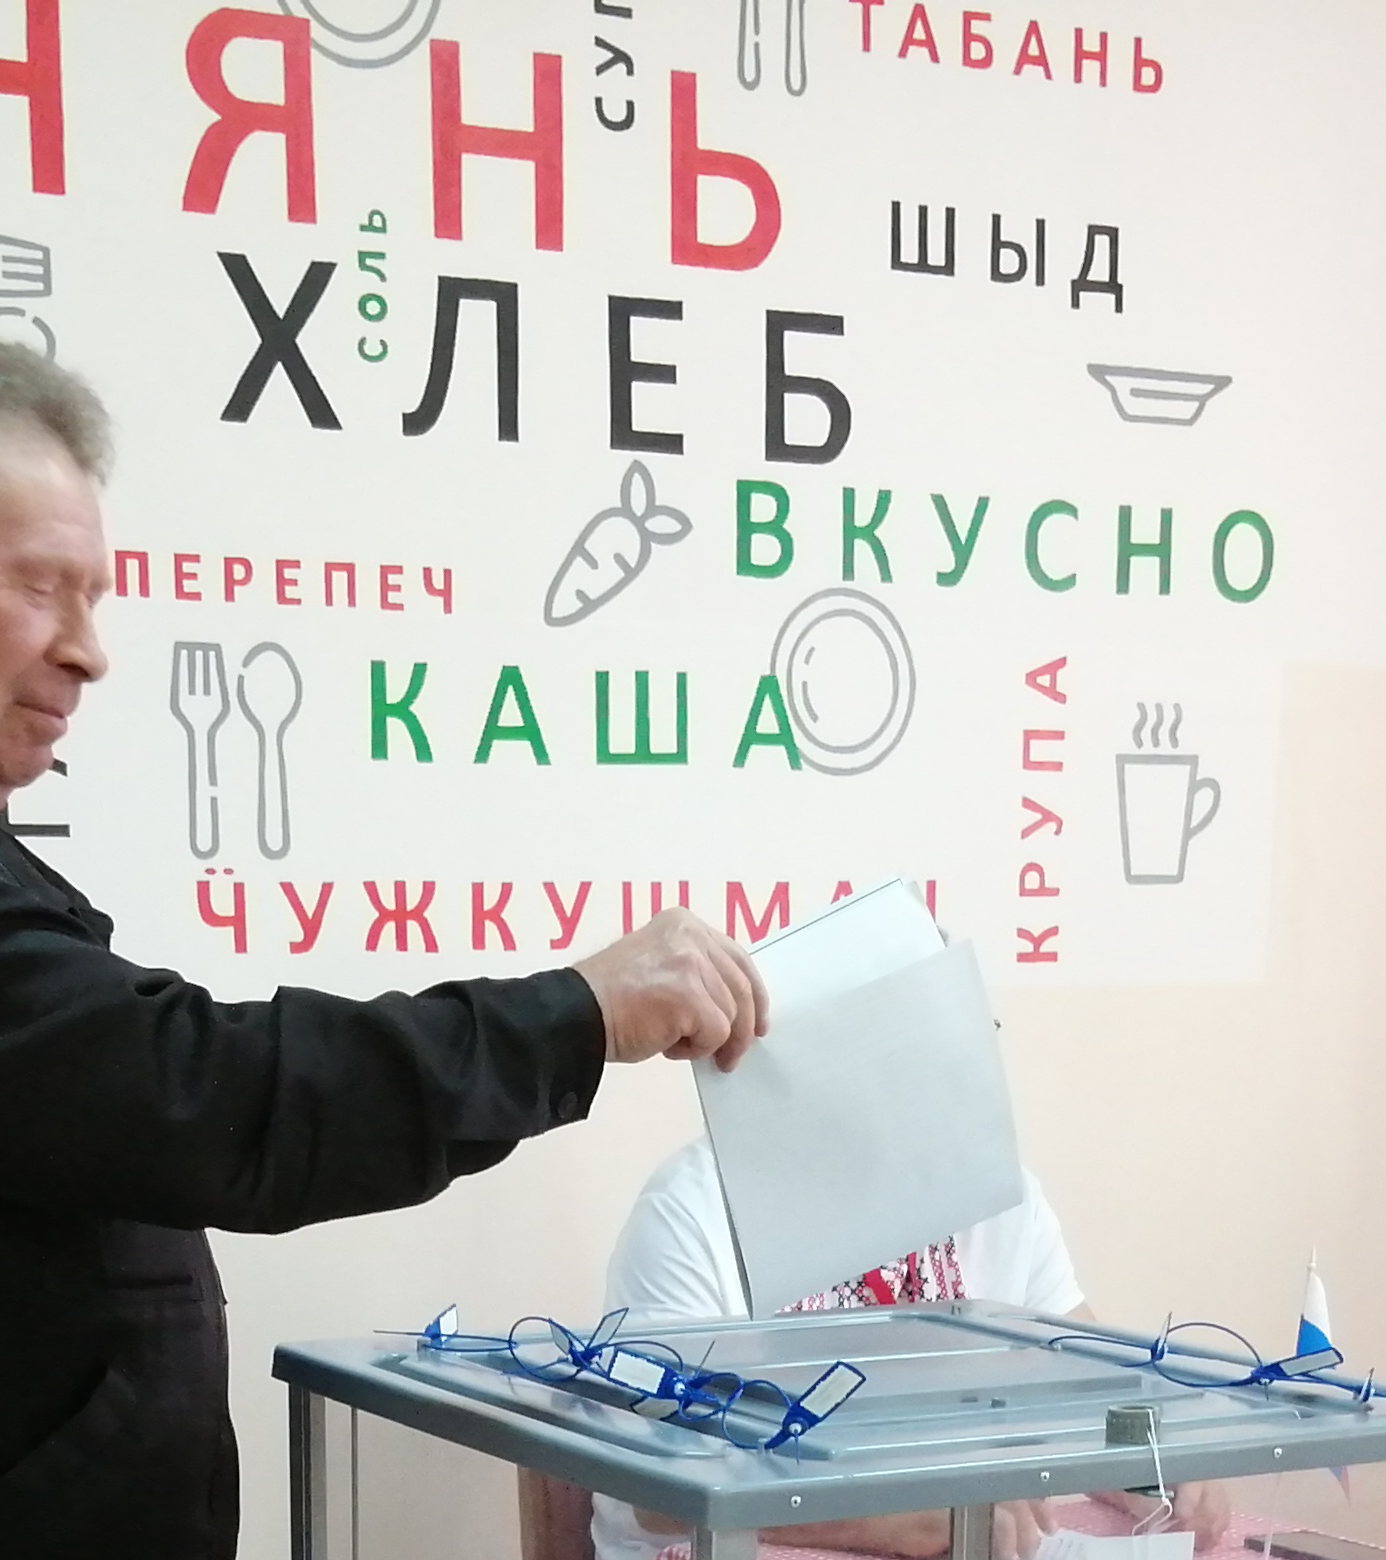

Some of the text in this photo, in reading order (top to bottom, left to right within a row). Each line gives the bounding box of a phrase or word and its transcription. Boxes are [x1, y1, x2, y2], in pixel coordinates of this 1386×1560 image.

[848, 0, 1164, 94] ТАБАНЬ
[357, 208, 389, 363] СОЛЬ
[891, 200, 1124, 314] ШЫД
[216, 251, 853, 465] ХЛЕБ
[114, 549, 453, 614] ПЕРЕПЕЧ
[735, 480, 1274, 603] ВКУСНО
[370, 660, 803, 770] КАША
[1016, 656, 1068, 964] КРУПА
